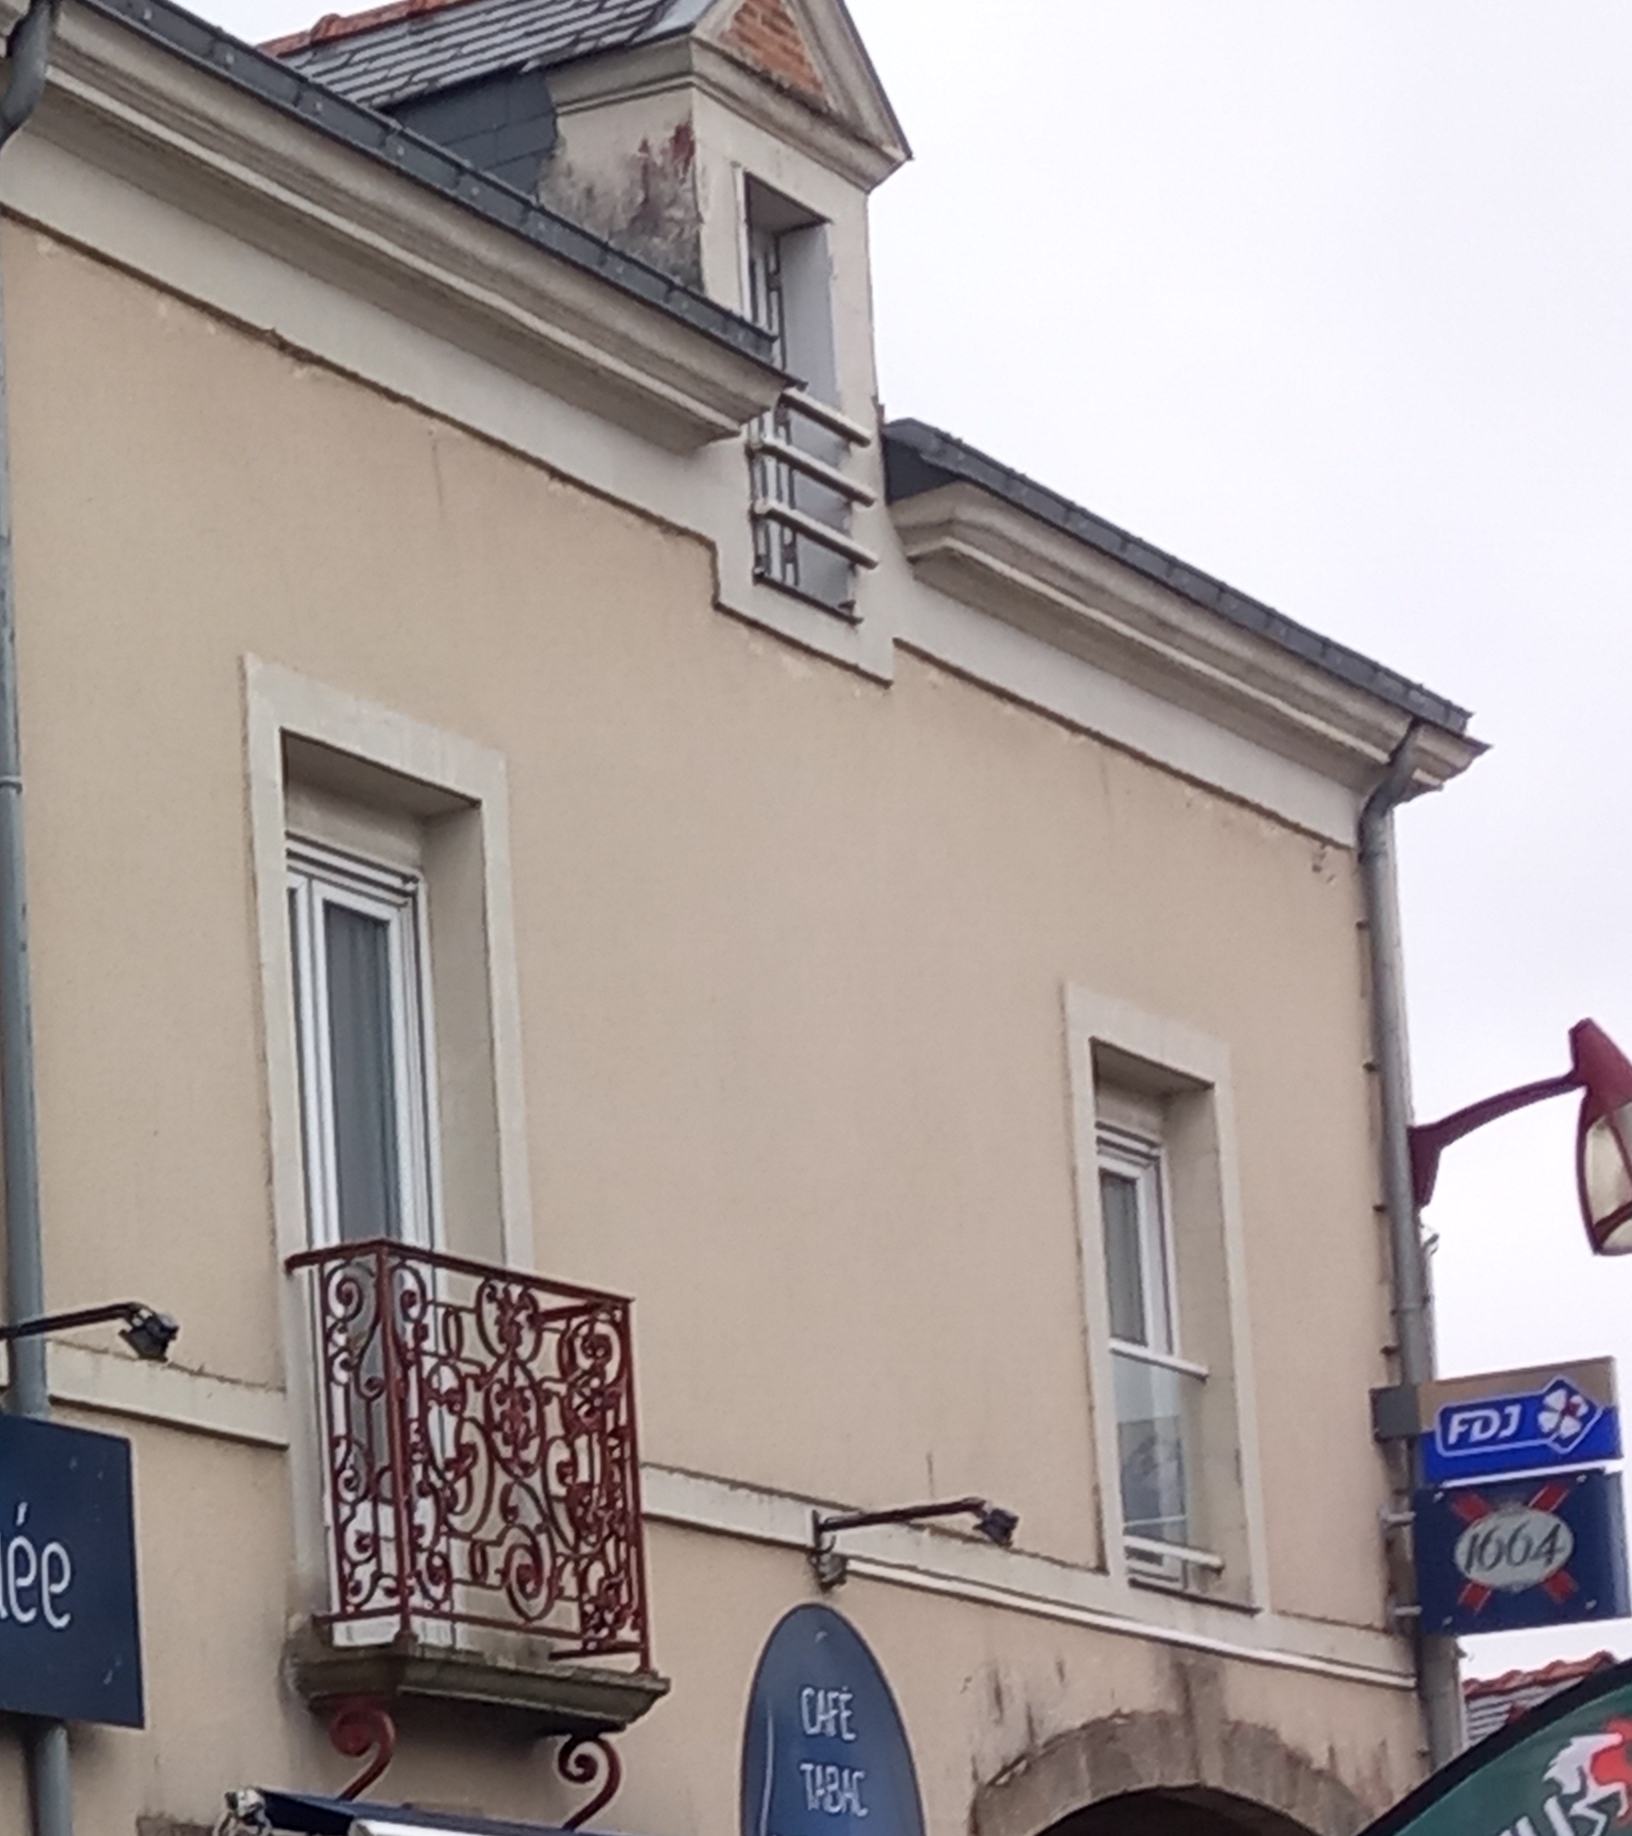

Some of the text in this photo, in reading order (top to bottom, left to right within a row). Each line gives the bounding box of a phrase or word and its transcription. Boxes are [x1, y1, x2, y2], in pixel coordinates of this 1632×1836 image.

[1448, 1403, 1523, 1446] FDJ
[1464, 1521, 1564, 1574] 1664
[800, 1763, 869, 1816] TABAC
